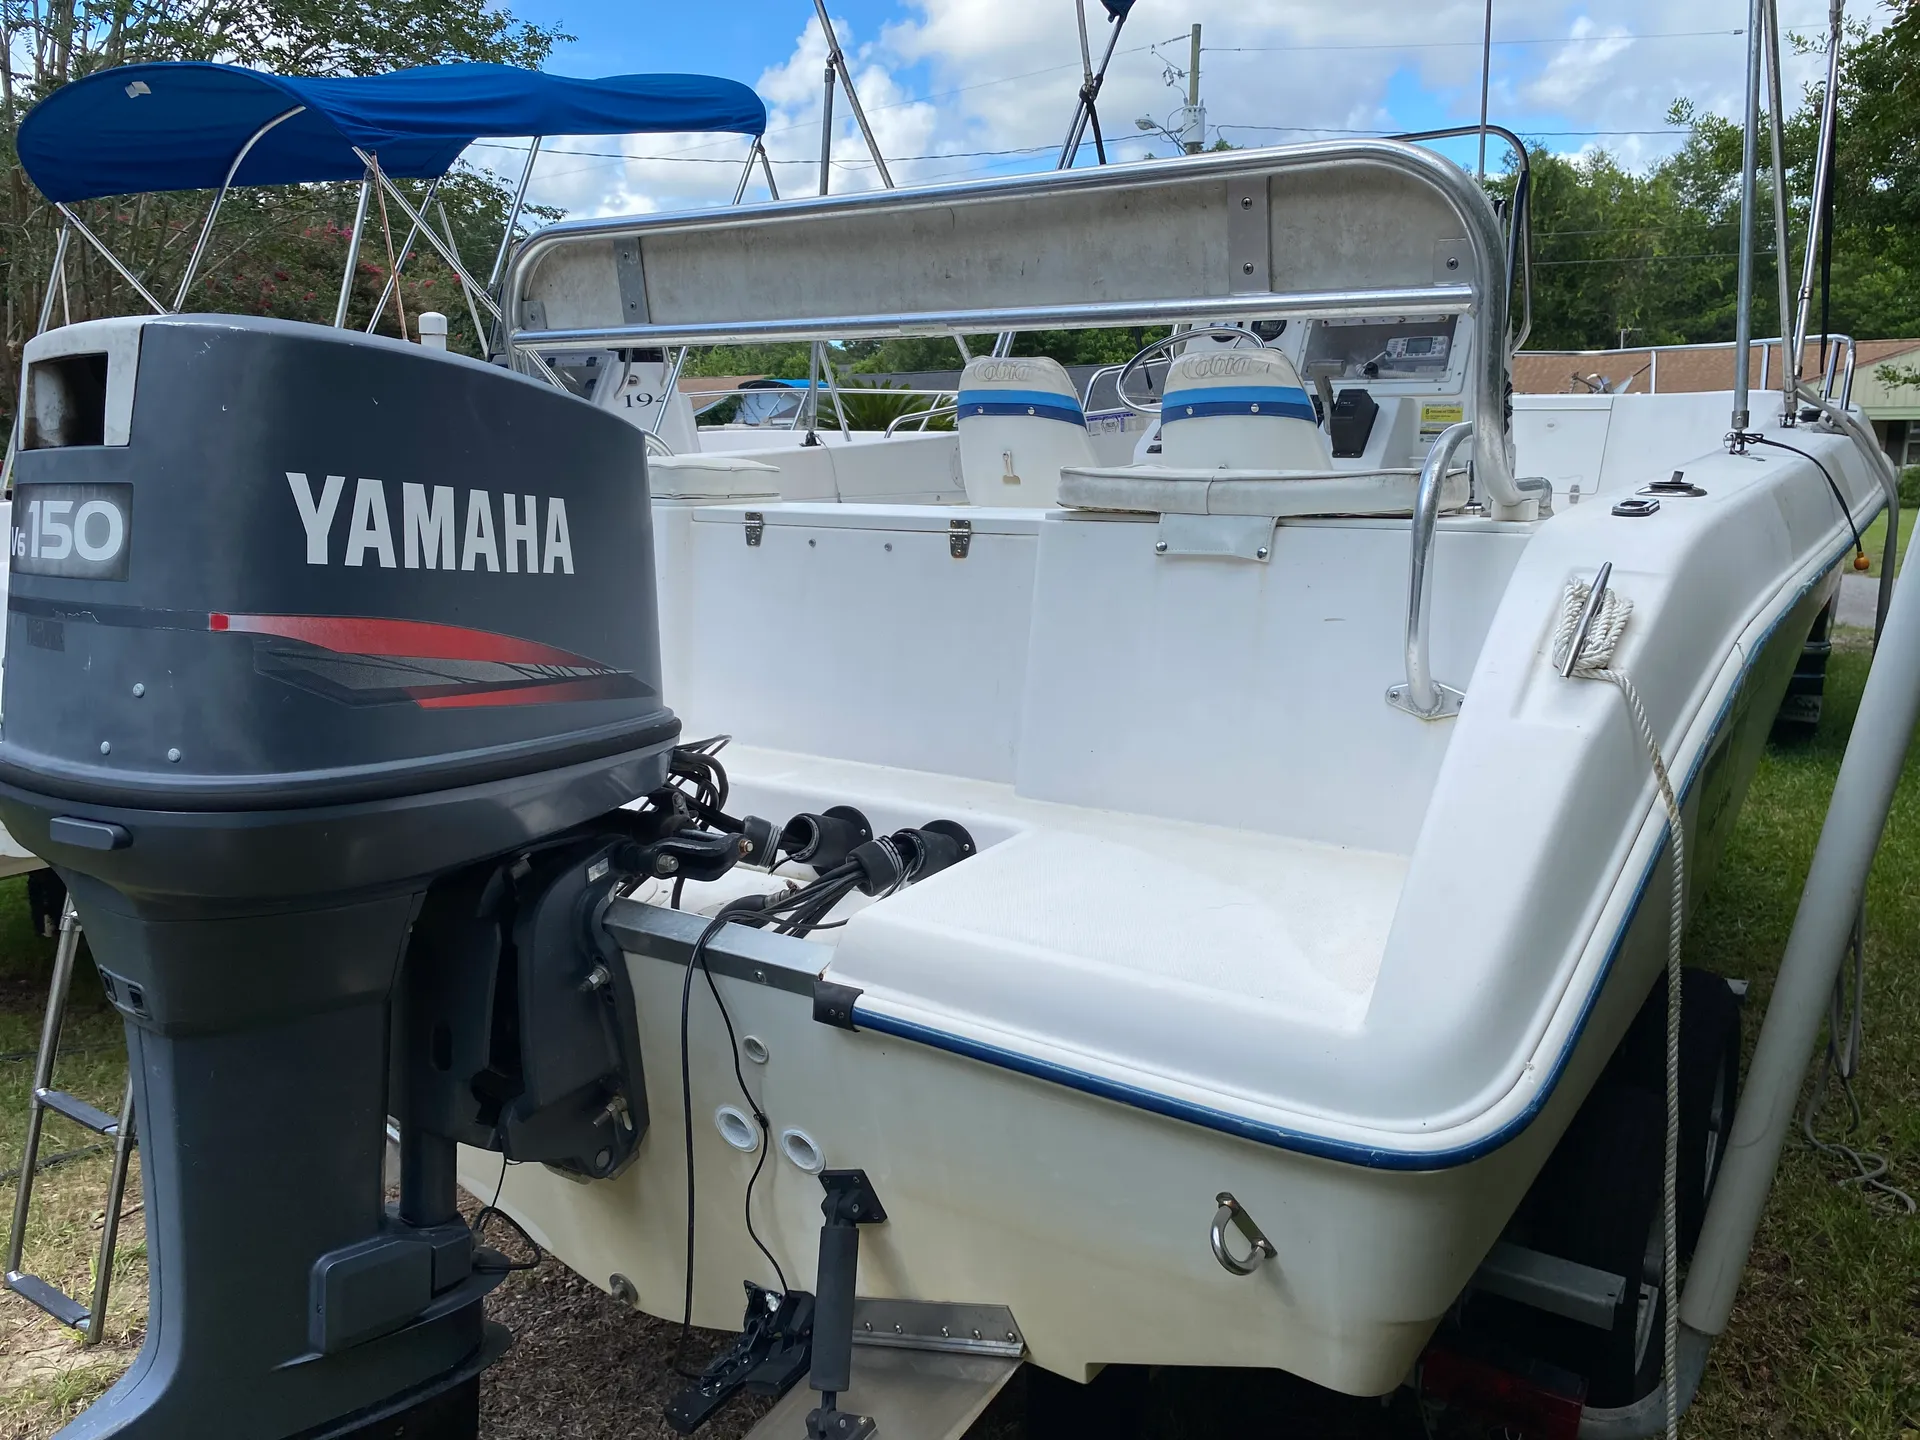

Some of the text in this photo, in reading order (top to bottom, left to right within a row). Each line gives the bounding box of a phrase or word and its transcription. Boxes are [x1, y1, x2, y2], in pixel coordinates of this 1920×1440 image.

[11, 499, 124, 562] V6 150
[284, 472, 575, 575] YAMAHA
